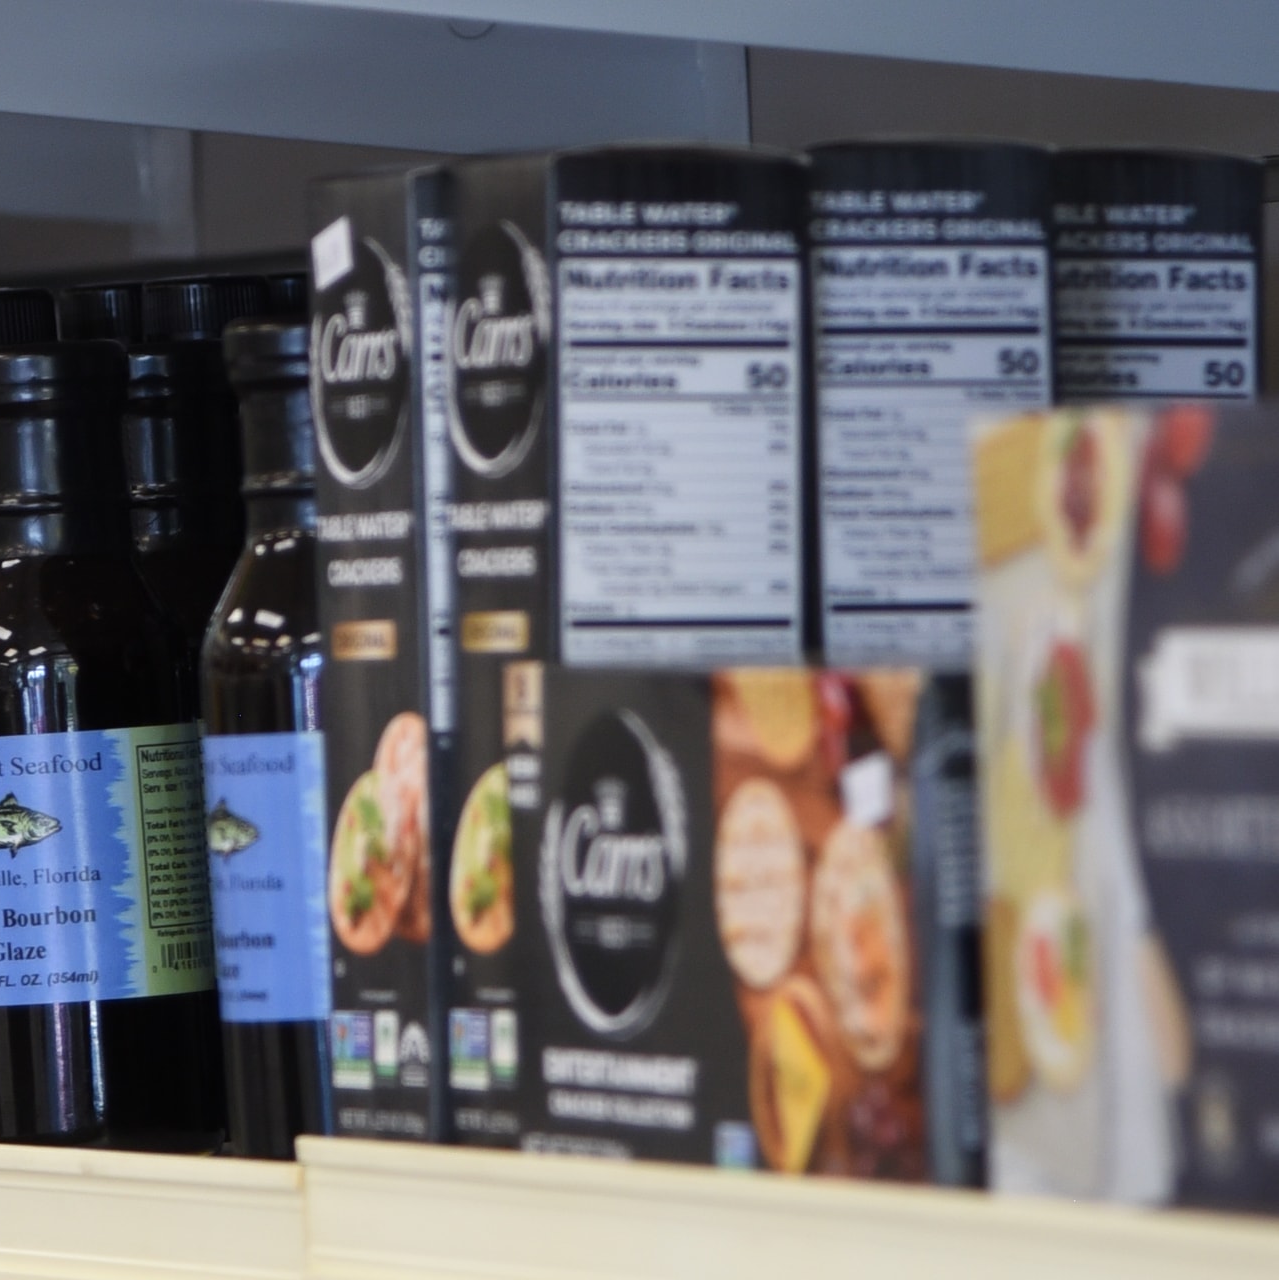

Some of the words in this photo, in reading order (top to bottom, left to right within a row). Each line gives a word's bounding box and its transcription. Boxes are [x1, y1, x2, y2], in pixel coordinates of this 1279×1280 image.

[822, 256, 951, 279] Nutrition
[959, 254, 1039, 279] Facts
[1169, 267, 1246, 291] Facts
[998, 349, 1040, 375] 50
[1204, 361, 1246, 388] 50
[746, 362, 788, 389] 50
[10, 751, 102, 777] Seafood
[33, 867, 101, 885] Florida
[2, 905, 96, 929] Bourbon
[21, 974, 43, 986] OZ.
[47, 970, 99, 987] (354ml)
